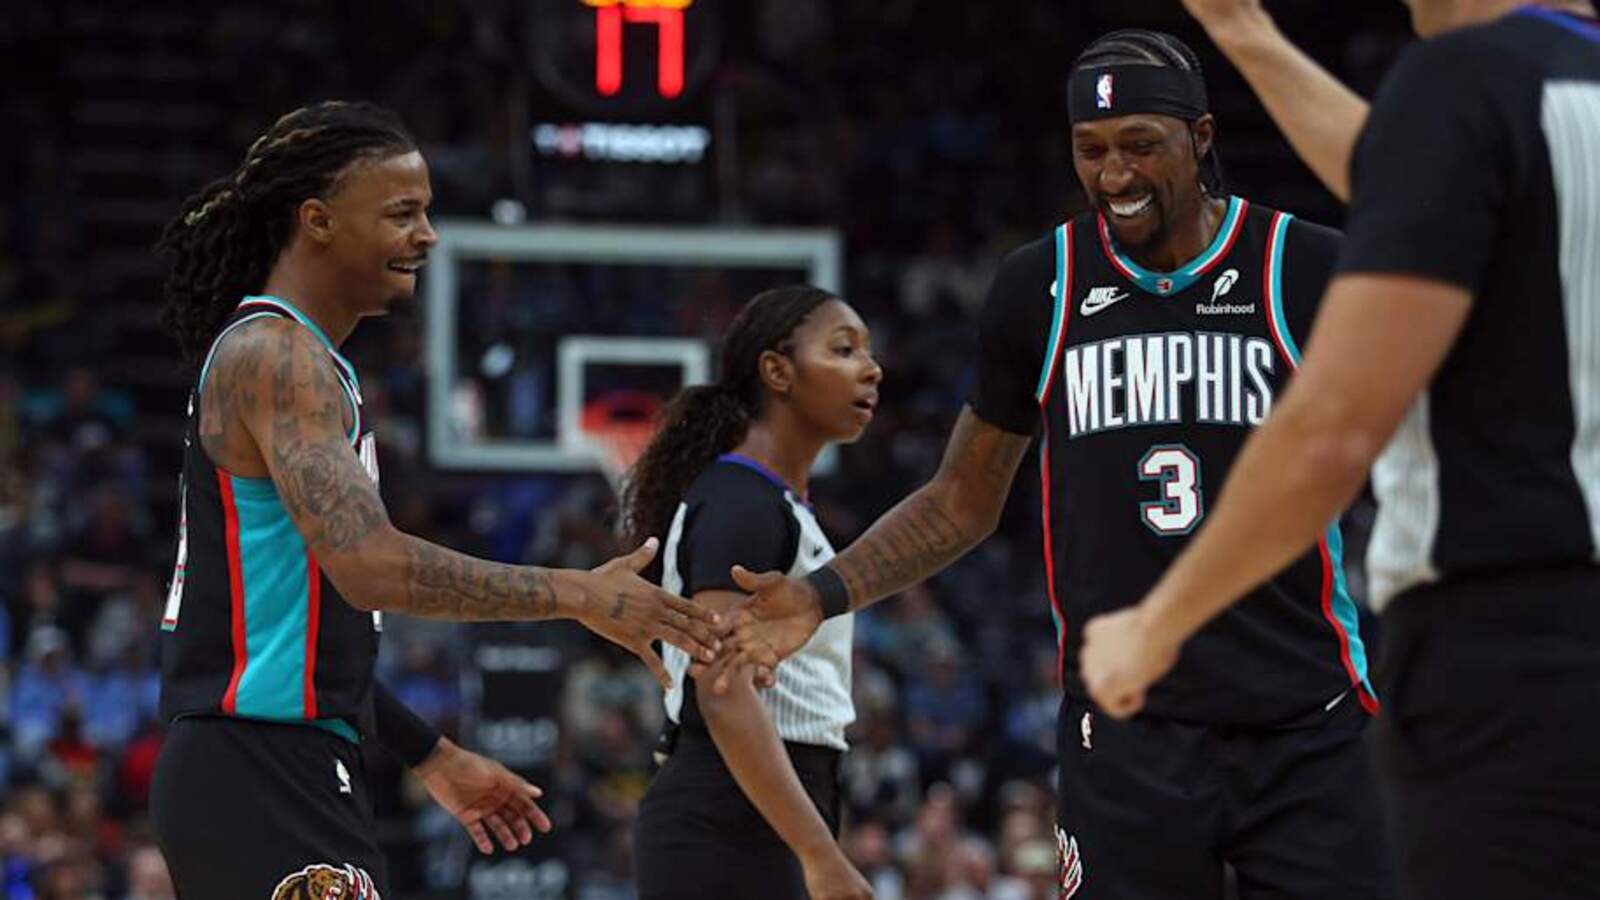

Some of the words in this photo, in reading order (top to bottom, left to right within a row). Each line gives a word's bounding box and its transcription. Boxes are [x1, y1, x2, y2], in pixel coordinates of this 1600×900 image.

[1087, 287, 1118, 303] NIKE
[1196, 303, 1255, 315] Robinhood
[1065, 331, 1274, 438] MEMPHIS
[1138, 444, 1203, 536] 3
